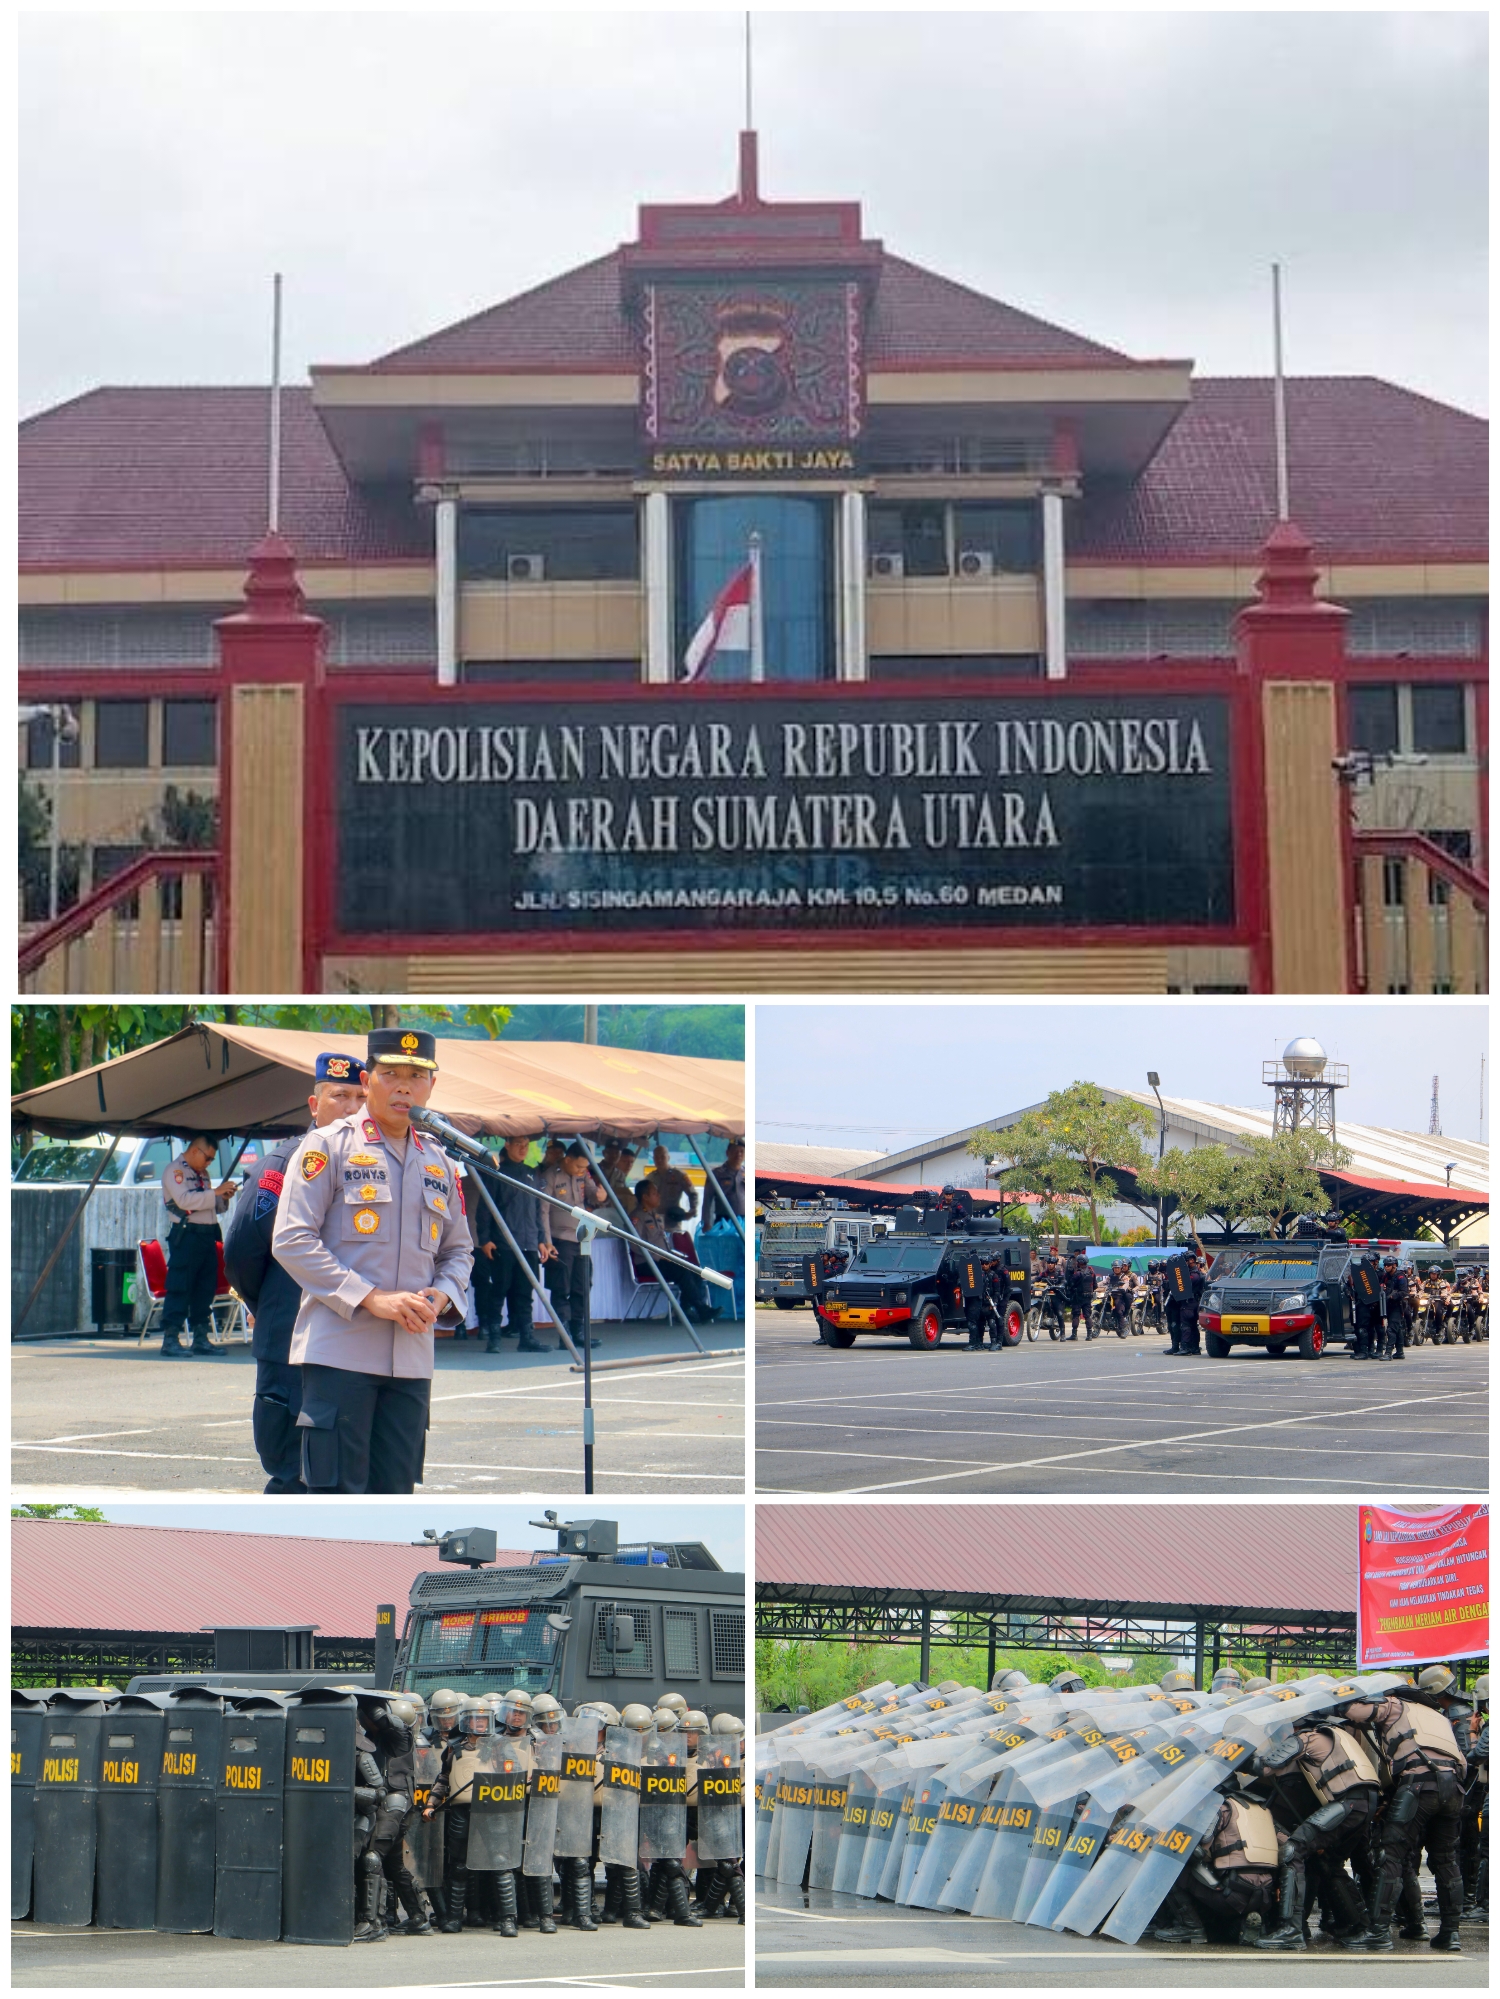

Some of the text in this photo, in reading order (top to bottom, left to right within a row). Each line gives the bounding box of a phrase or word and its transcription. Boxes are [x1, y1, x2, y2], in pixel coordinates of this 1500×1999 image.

[653, 451, 854, 471] SATYA BAKTI JAYA
[357, 719, 1209, 782] KEPOLISIAN NEGARA REPUBLIK INDONESIA
[514, 792, 1061, 853] DAERAH SUMATERA UTARA
[568, 886, 801, 909] SISINGAMANGARAJA
[977, 885, 1063, 906] MEDAN
[344, 1169, 386, 1181] RONY.S
[1009, 1270, 1025, 1281] IMOB
[481, 1612, 526, 1623] BRIMOB
[1415, 1610, 1442, 1627] MERIAM
[1444, 1608, 1457, 1623] AIR
[1459, 1602, 1489, 1620] DENGA
[43, 1758, 79, 1782] POLISI
[103, 1760, 139, 1784] POLISI
[163, 1752, 197, 1775] POLISI
[291, 1756, 331, 1783] POLISI
[566, 1758, 596, 1776] POLI
[225, 1765, 262, 1789] POLISI
[538, 1775, 559, 1793] POL
[647, 1777, 687, 1793] POLISI
[478, 1784, 526, 1802] POLISI
[784, 1784, 813, 1805] OLISI
[814, 1788, 847, 1807] OLISI
[938, 1802, 976, 1825] OLISI
[909, 1815, 937, 1835] OLIS
[1112, 1828, 1152, 1853] OLISI
